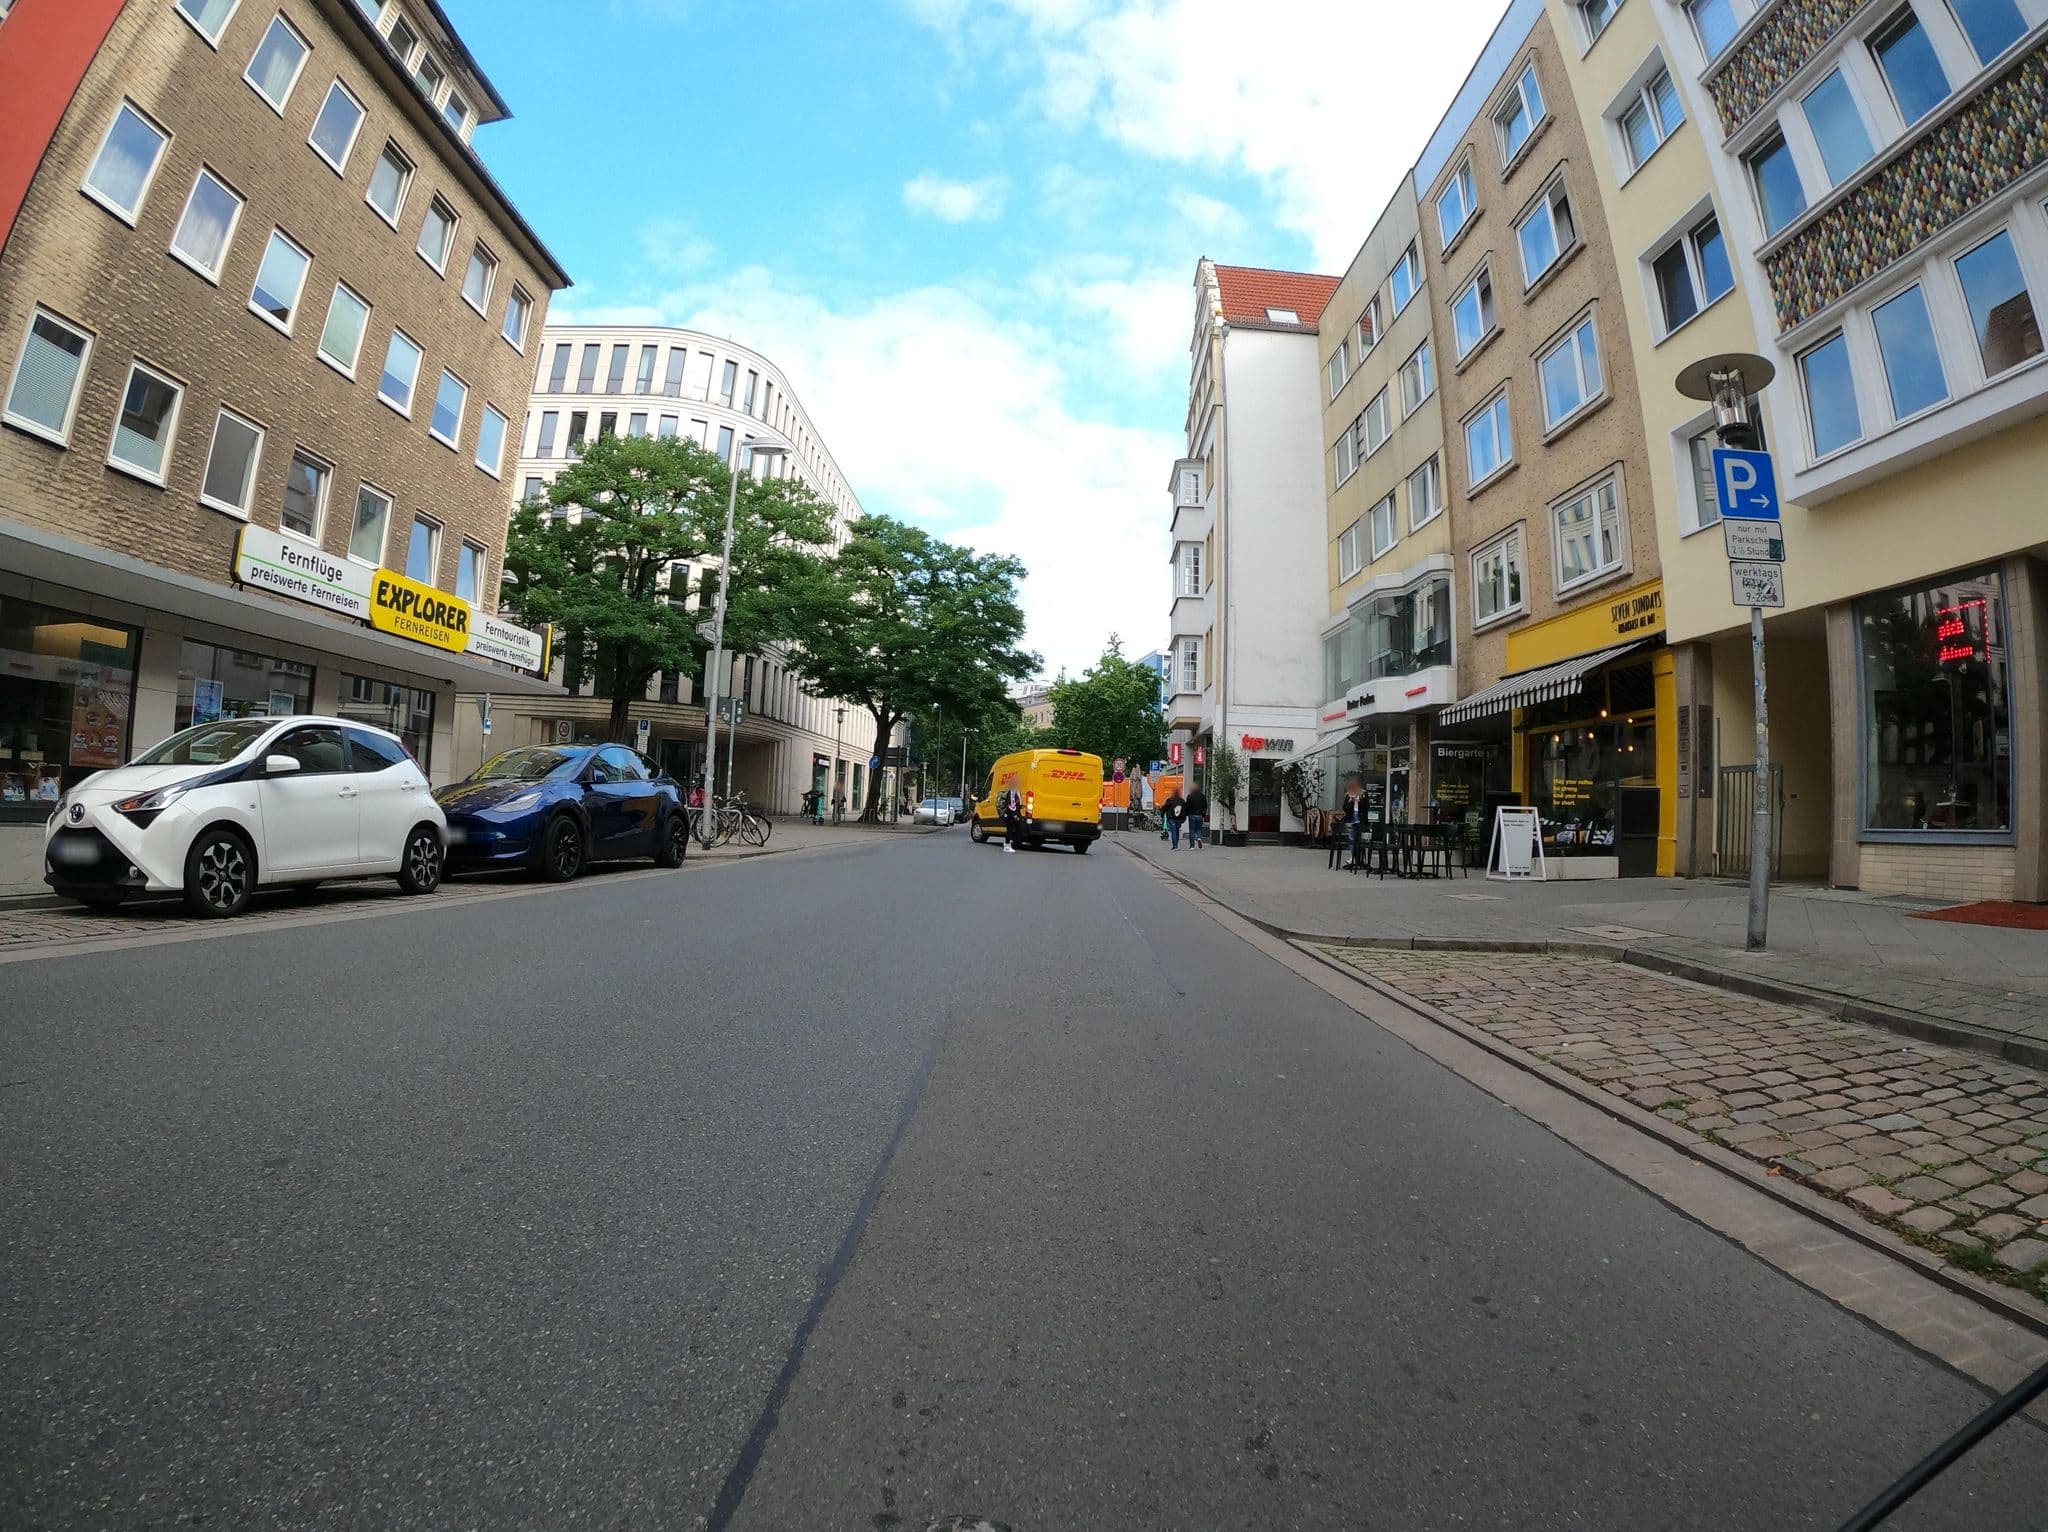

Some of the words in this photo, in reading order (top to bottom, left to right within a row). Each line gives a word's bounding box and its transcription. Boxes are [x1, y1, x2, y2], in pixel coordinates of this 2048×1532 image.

[1723, 457, 1757, 509] P
[1732, 534, 1770, 545] Parksche
[1754, 526, 1768, 534] mit
[281, 545, 343, 582] Fernflüge
[1746, 546, 1770, 558] Stund
[1734, 567, 1779, 579] werktags
[250, 566, 308, 593] preiswerte
[310, 583, 359, 610] Fernreisen
[376, 579, 468, 634] EXPLORER
[1611, 600, 1631, 623] SEVEN
[1632, 590, 1662, 617] SUNDAYS
[394, 616, 450, 644] FERNREISEN
[485, 621, 531, 648] Ferntouristik
[475, 641, 508, 658] preiswerte
[509, 650, 535, 668] Fernflüge
[1241, 734, 1294, 753] tipwin
[1050, 769, 1087, 781] DHL
